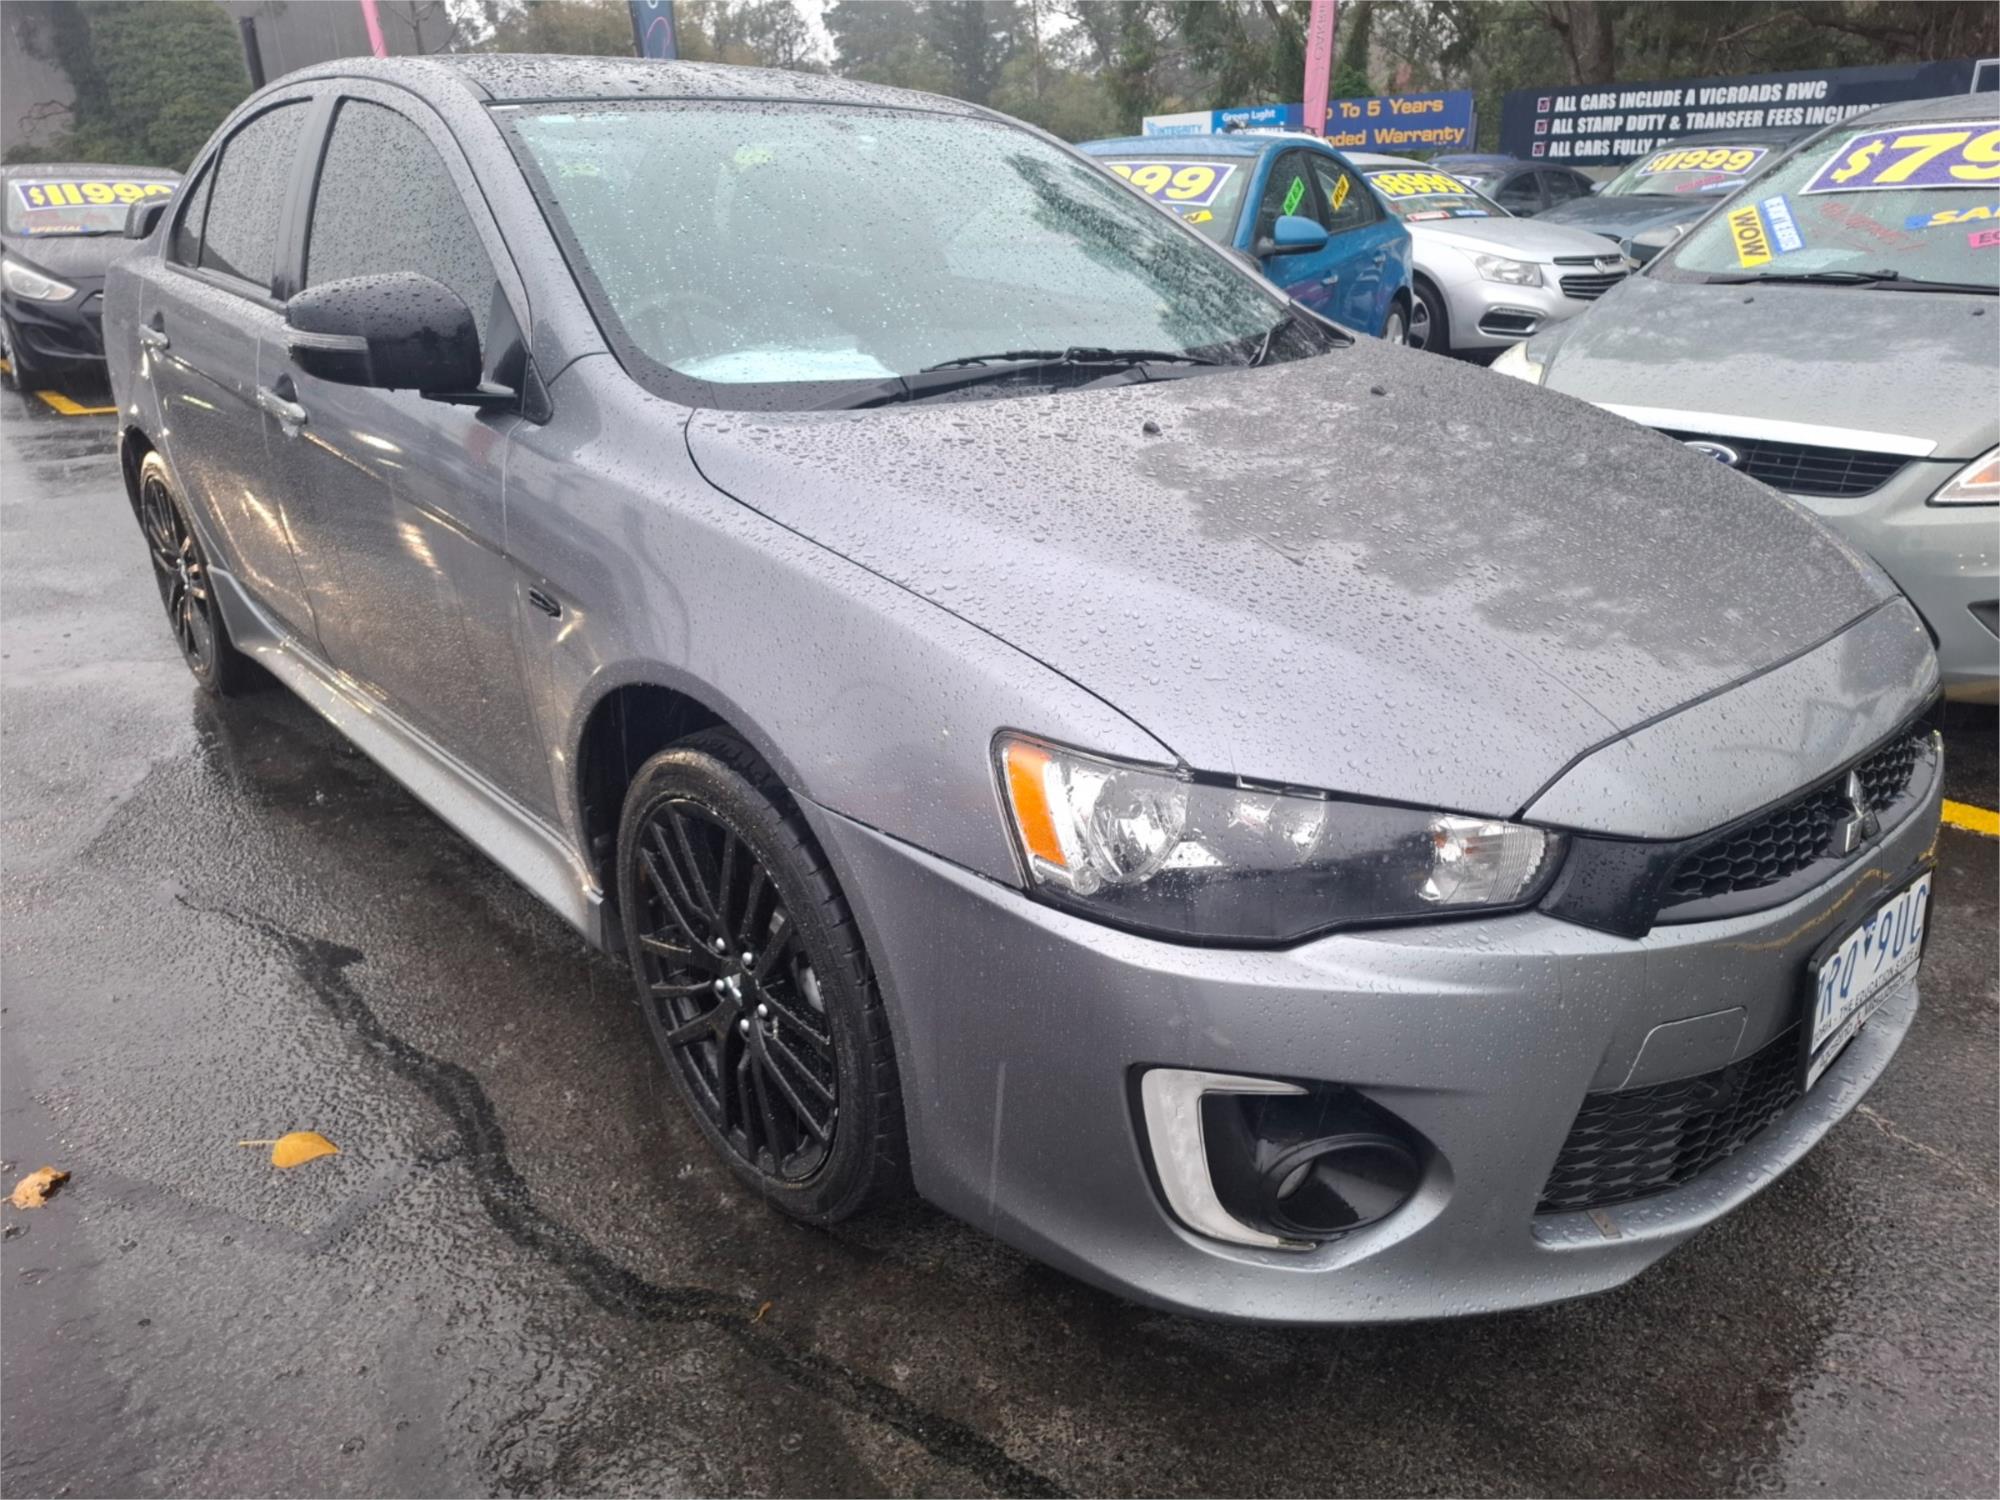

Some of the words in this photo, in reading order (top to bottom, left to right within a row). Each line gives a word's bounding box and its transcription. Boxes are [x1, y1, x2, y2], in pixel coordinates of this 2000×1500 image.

[1554, 96, 1577, 112] ALL
[1580, 93, 1616, 111] CARS
[1619, 89, 1682, 109] INCLUDE
[1684, 88, 1696, 106] A
[1700, 83, 1783, 105] VICROADS
[1785, 80, 1828, 100] RWC
[1222, 112, 1249, 122] Green
[1251, 108, 1276, 121] Light
[1340, 103, 1361, 118] To
[1367, 101, 1381, 117] 5
[1389, 98, 1445, 115] Years
[1551, 118, 1573, 134] ALL
[1577, 115, 1624, 133] STAMP
[1626, 114, 1667, 132] DUTY
[1669, 115, 1681, 130] &
[1686, 110, 1764, 130] TRANSFER
[1766, 107, 1805, 127] FEES
[1374, 126, 1466, 145] Warranty
[1549, 141, 1571, 157] ALL
[1574, 139, 1611, 156] CARS
[1613, 138, 1653, 155] FULLY
[1646, 149, 1755, 171] $11999
[1370, 173, 1465, 195] $8999
[1733, 210, 1768, 257] WOW
